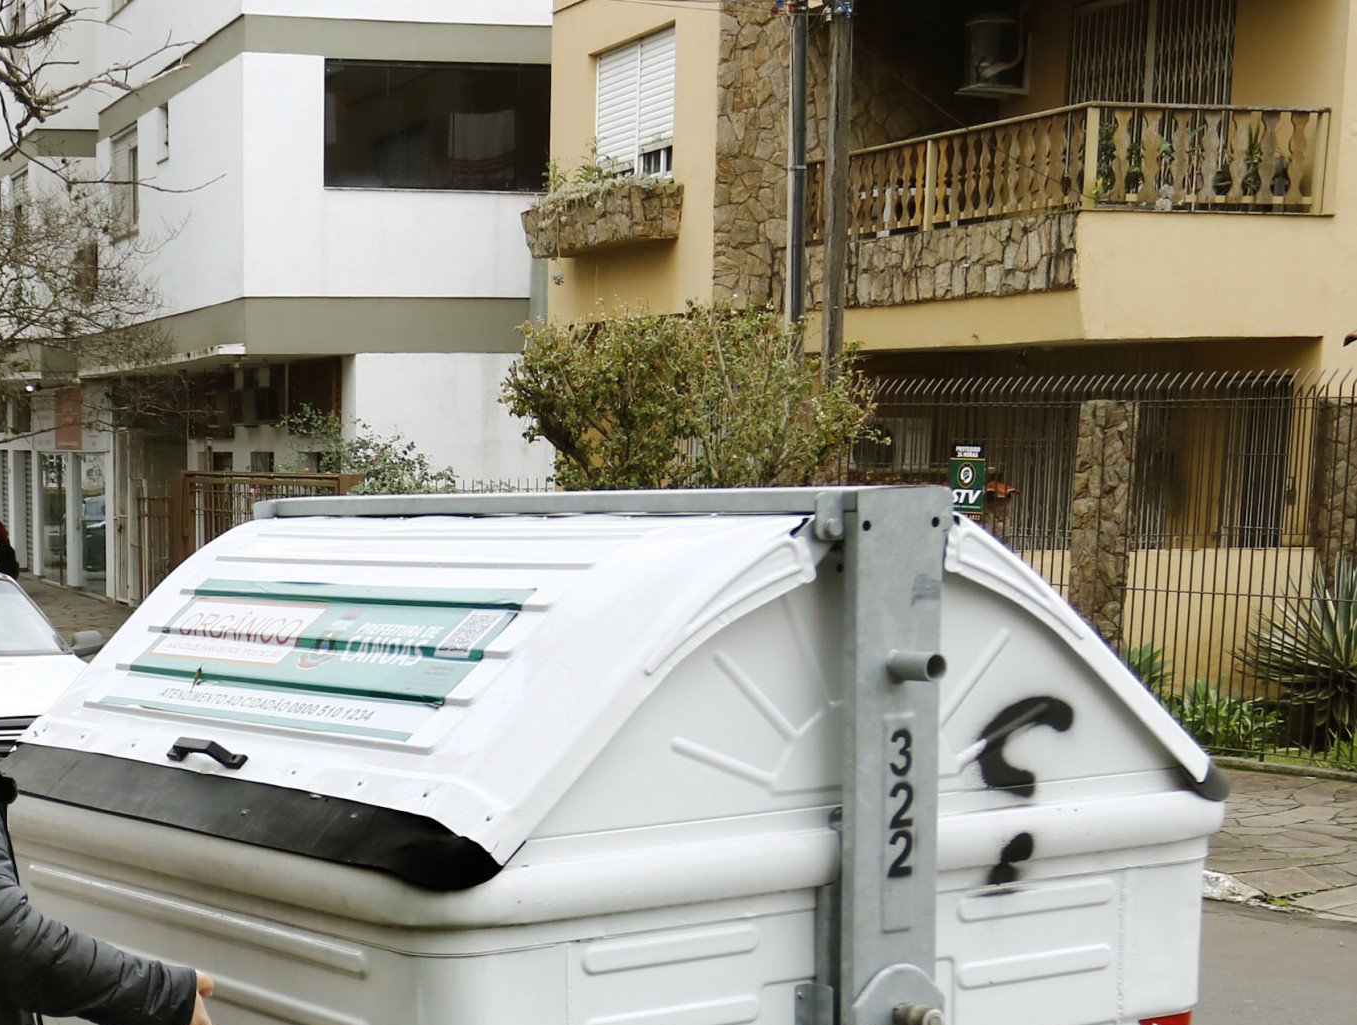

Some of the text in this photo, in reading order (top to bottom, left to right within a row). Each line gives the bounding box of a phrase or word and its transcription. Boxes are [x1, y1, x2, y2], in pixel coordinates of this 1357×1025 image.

[952, 488, 982, 504] STV
[179, 611, 303, 645] ORGÂNICO
[356, 622, 443, 638] PREFEITURA DE
[340, 635, 431, 666] CANOAS
[158, 687, 377, 721] ATENDIMENTO AO CIDADÃO 0800 510 1234
